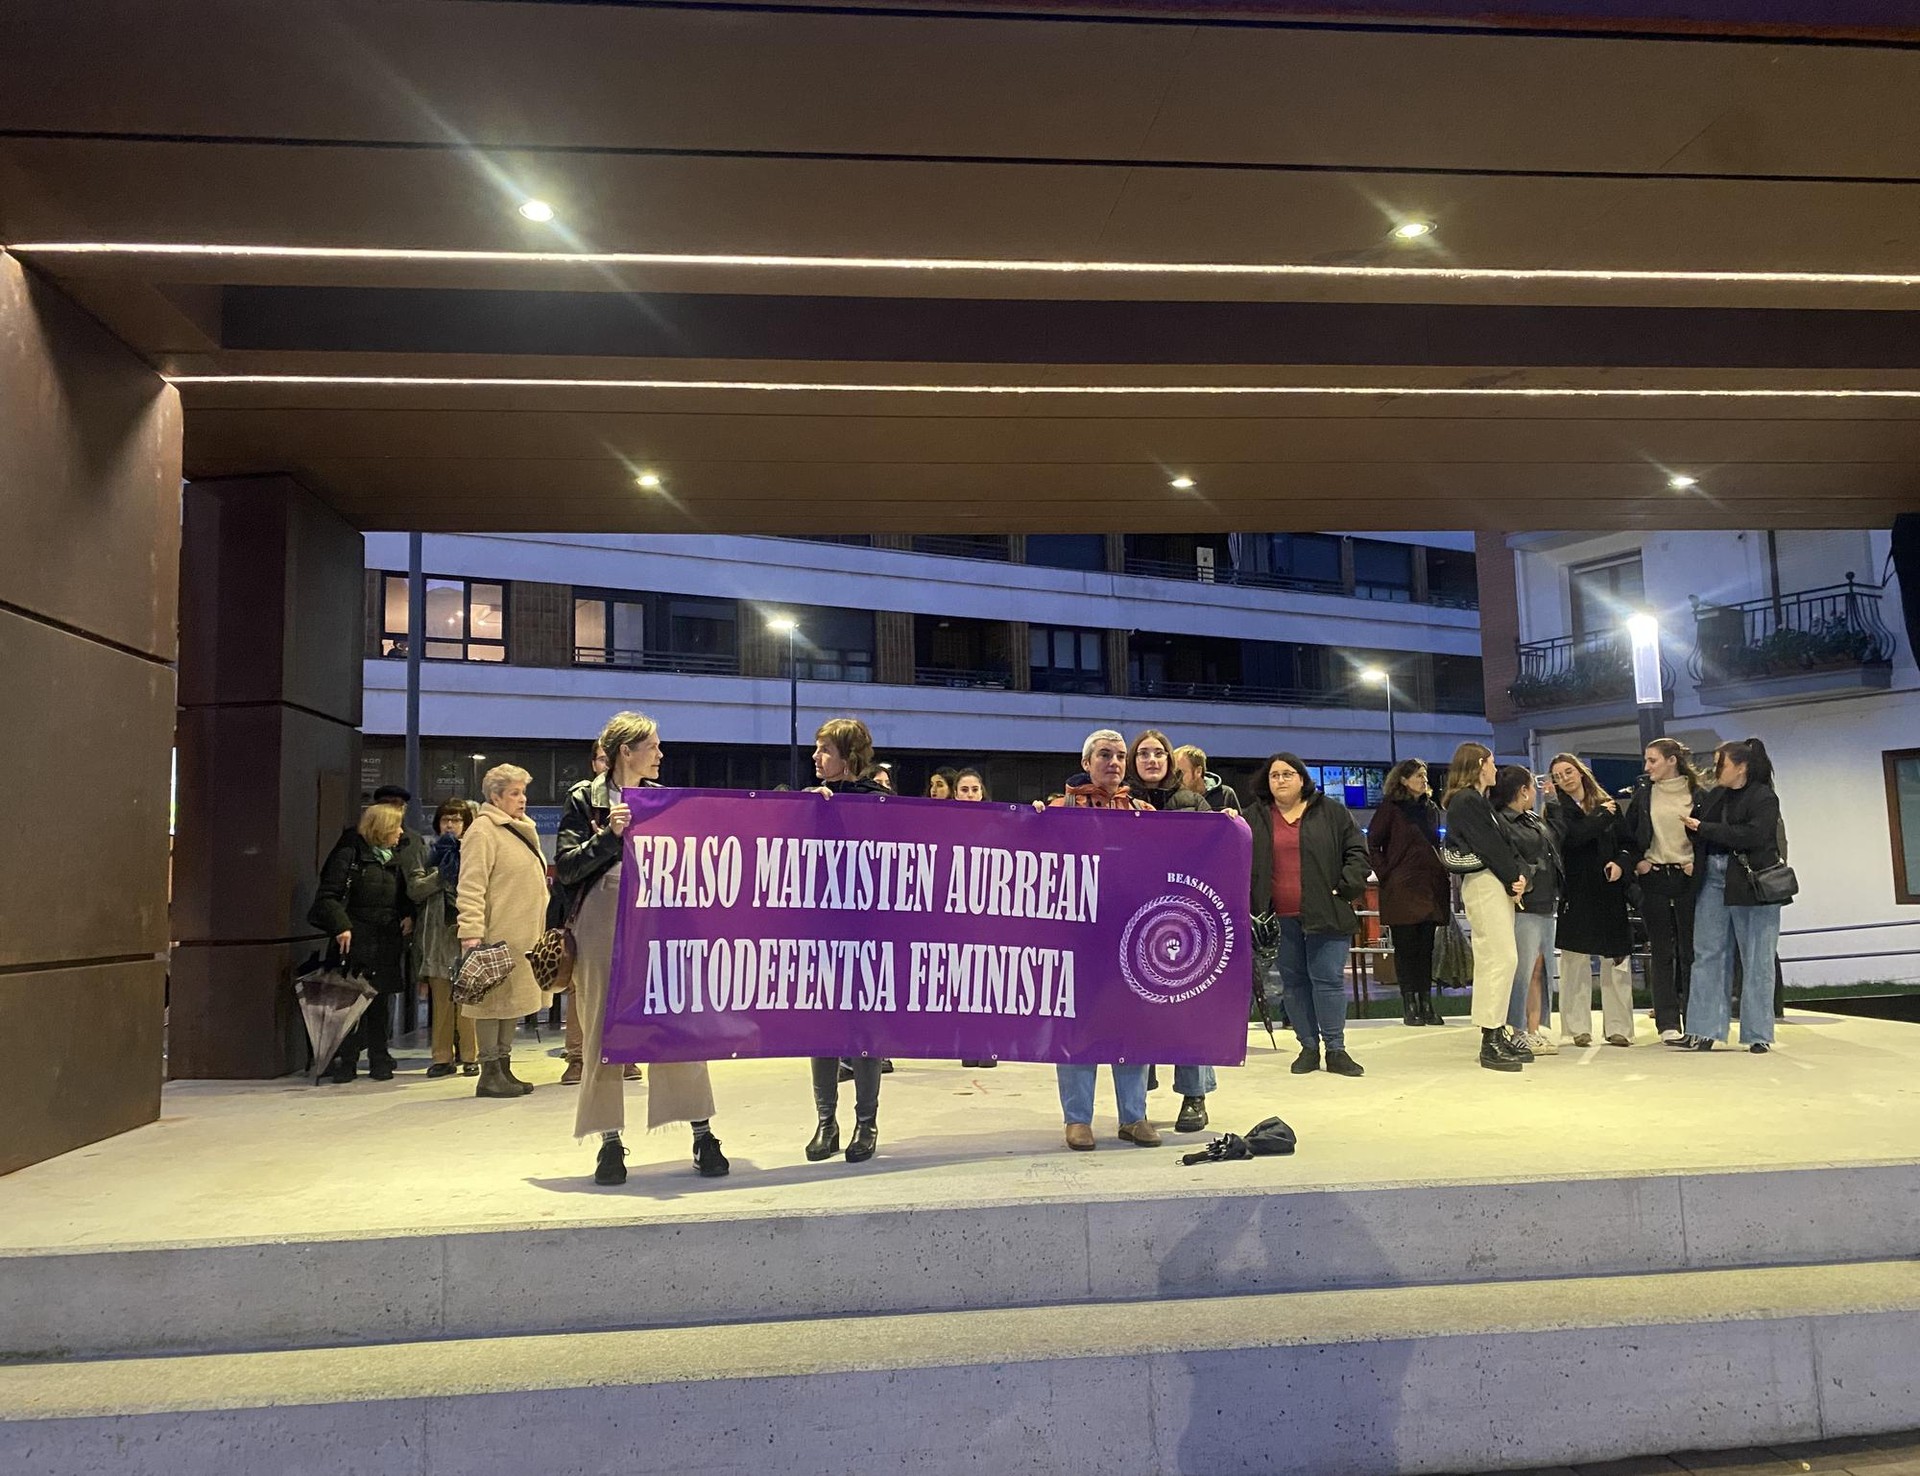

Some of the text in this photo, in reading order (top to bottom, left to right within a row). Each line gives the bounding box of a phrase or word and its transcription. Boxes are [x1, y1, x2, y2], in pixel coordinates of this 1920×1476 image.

[633, 835, 1101, 923] ERASO MATXISTEN AURREAN
[643, 938, 1077, 1019] AUTODEFENTSA FEMINISTA
[1167, 872, 1235, 1004] BEASAINGO ASANBLADA FEMINISTA
